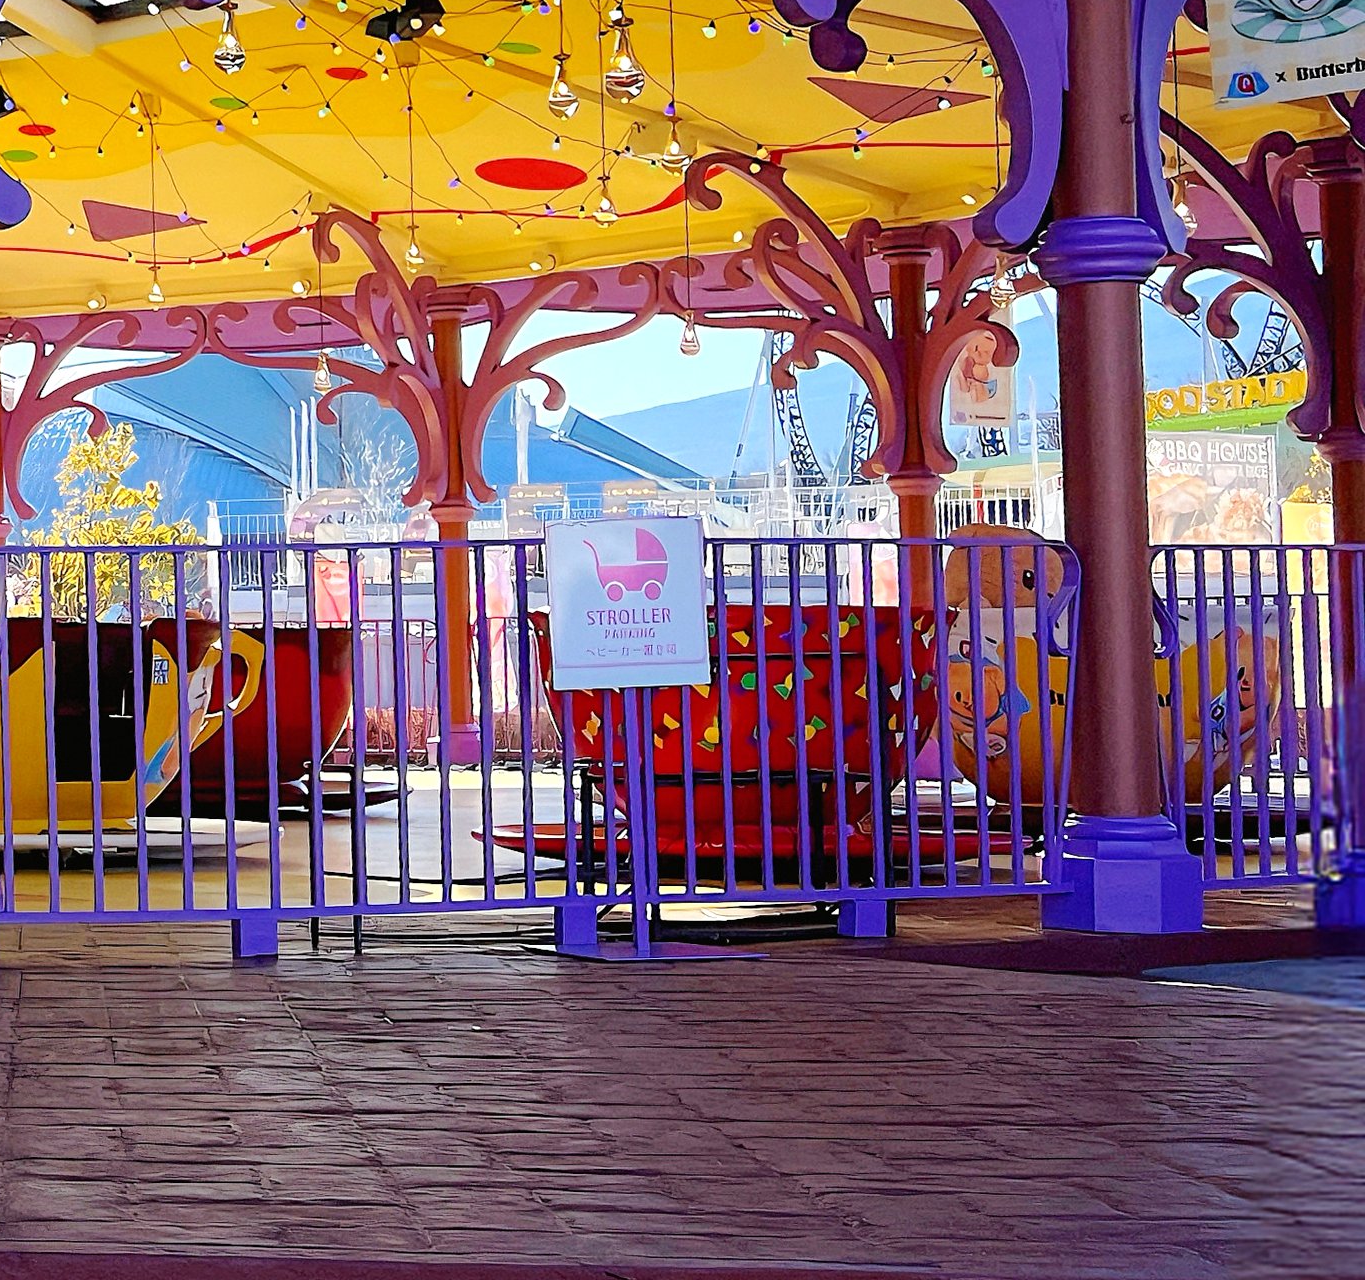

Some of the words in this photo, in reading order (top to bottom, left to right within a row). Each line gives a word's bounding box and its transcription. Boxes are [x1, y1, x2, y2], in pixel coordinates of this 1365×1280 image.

[1165, 440, 1202, 462] BBQ
[1208, 441, 1268, 464] HOUSE
[586, 608, 672, 626] STROLLER
